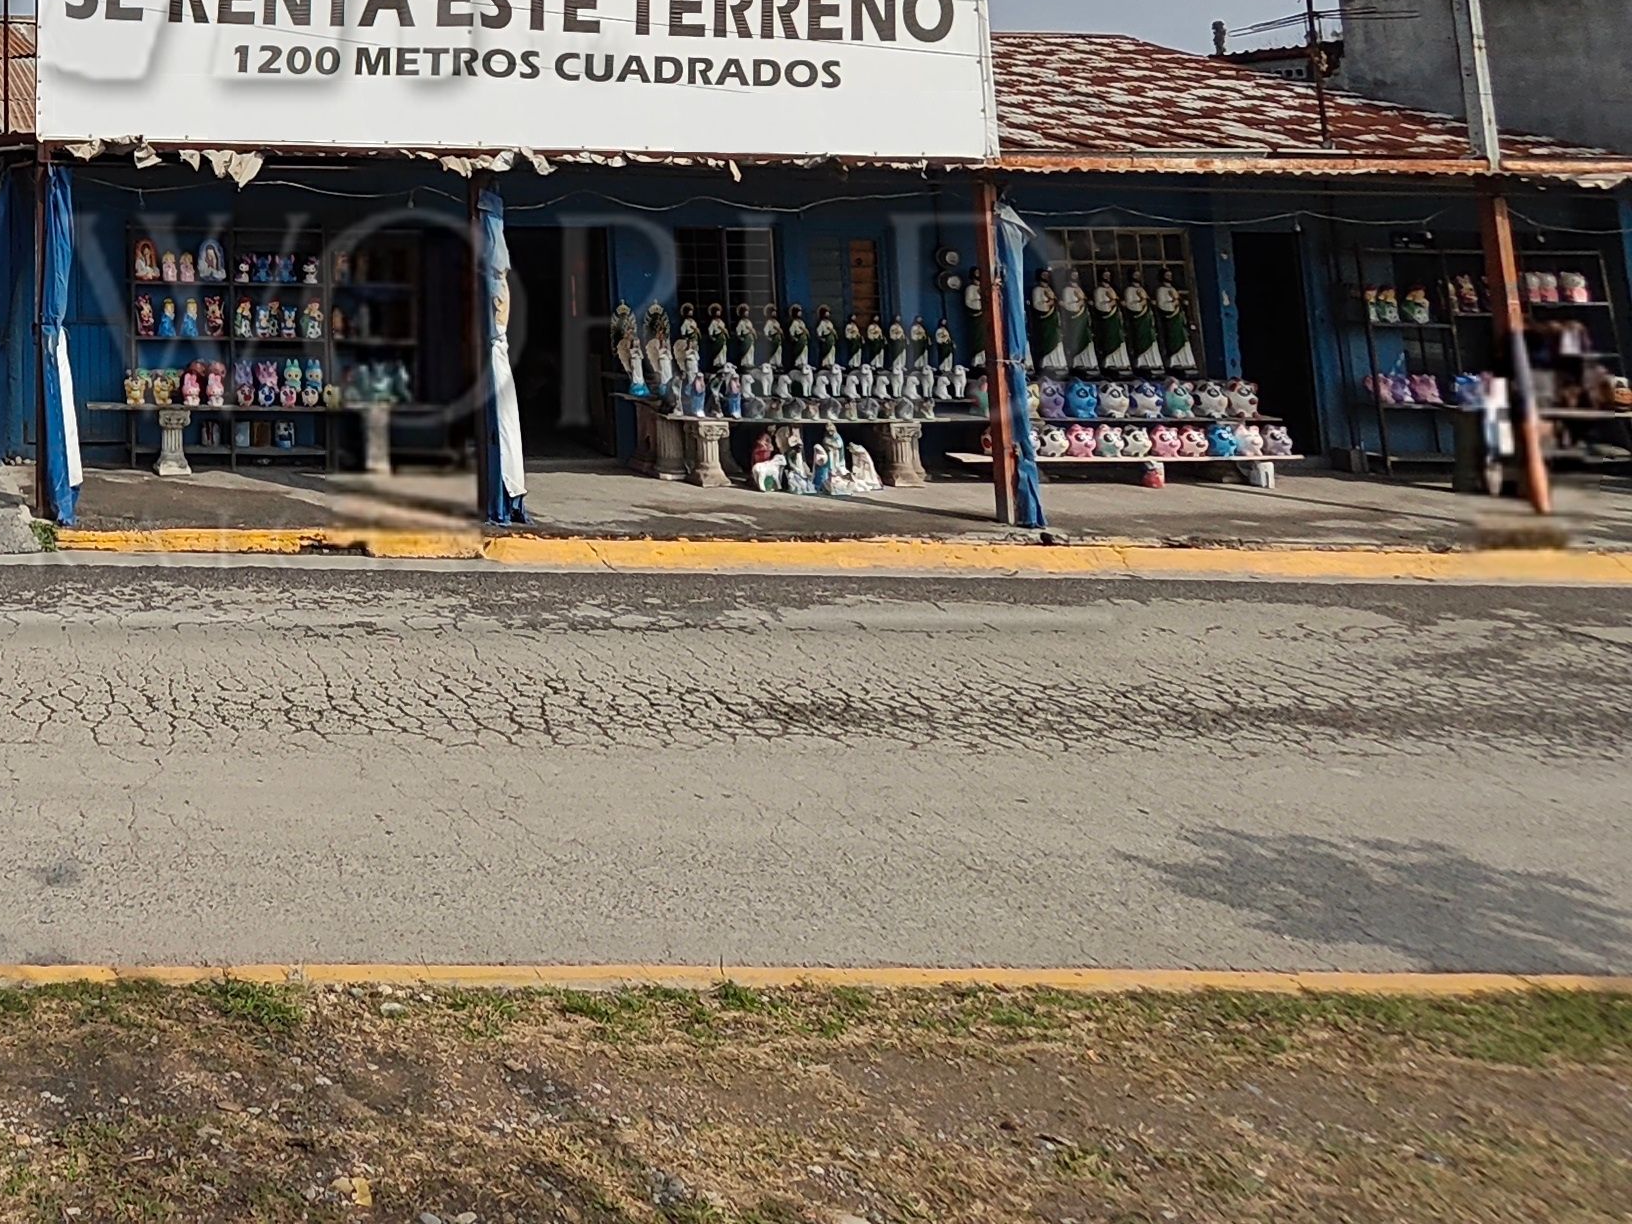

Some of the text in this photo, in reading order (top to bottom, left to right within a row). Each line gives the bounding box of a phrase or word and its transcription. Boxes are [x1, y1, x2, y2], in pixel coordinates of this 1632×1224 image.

[234, 44, 842, 88] 1200 METROS CUADRADOS
